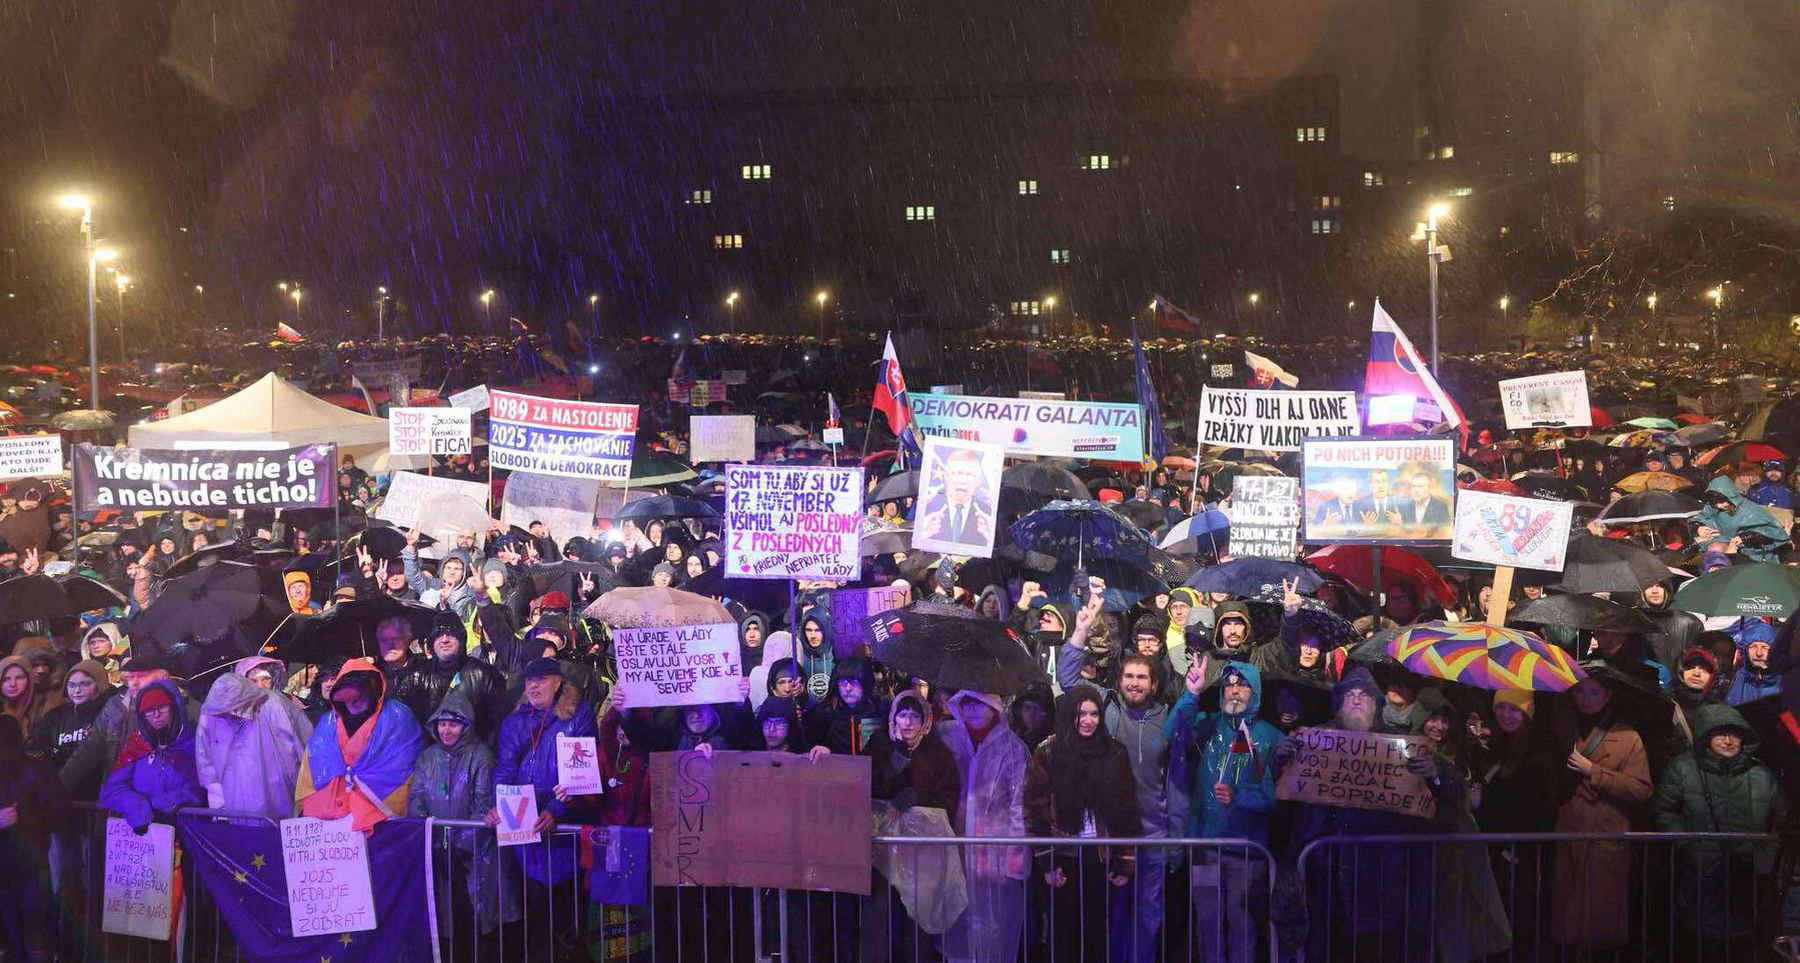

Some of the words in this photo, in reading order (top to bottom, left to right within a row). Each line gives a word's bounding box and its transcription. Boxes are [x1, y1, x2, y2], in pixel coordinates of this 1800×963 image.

[493, 397, 529, 421] 1989
[533, 406, 548, 421] ZA
[552, 408, 633, 429] NASTOLENIE
[912, 400, 1030, 423] DEMOKRATI
[1036, 405, 1138, 428] GALANTA
[1208, 392, 1247, 418] VYŠŠÍ
[1256, 398, 1280, 420] DLH
[1288, 398, 1304, 420] AJ
[1311, 396, 1348, 421] DANE
[394, 411, 426, 425] STOP
[394, 426, 426, 438] STOP
[491, 424, 527, 449] 2025
[530, 432, 546, 448] ZA
[549, 434, 631, 456] ZACHOVANIE
[1204, 419, 1254, 444] ZRÁŽKY
[394, 438, 426, 453] STOP
[435, 438, 470, 453] FICA!
[1314, 447, 1331, 462] PO
[1337, 447, 1370, 462] NICH
[1376, 446, 1446, 461] POTOPA!!!
[94, 454, 228, 481] Kremnica
[236, 457, 281, 481] nie
[287, 454, 315, 483] je
[491, 450, 539, 469] SLOBODY
[541, 461, 547, 471] A
[550, 459, 627, 477] DEMOKRACIE
[97, 487, 114, 505] a
[118, 483, 228, 506] nebude
[233, 478, 317, 505] ticho!
[730, 470, 761, 490] SOM
[811, 473, 824, 491] SI
[830, 473, 850, 493] UŽ
[731, 491, 751, 511] 17.
[757, 491, 836, 512] NOVEMBER
[730, 510, 776, 532] VŠIMOL
[796, 511, 859, 534] POSLEDNÝ
[733, 532, 744, 550] Z
[752, 532, 842, 554] POSLEDNÝCH
[620, 633, 634, 644] NA
[638, 629, 670, 644] ÚRADE
[676, 626, 713, 641] VLÁDY
[871, 618, 890, 643] PARIS
[651, 643, 687, 656] STÁLE
[625, 671, 641, 683] MY
[644, 670, 664, 682] ALE
[667, 667, 698, 680] VIEME
[701, 666, 722, 678] KDE
[724, 664, 740, 677] JE
[1300, 769, 1321, 780] SA
[1339, 757, 1404, 778] KONIEC
[1297, 780, 1306, 792] V
[1317, 784, 1414, 809] POPRADE
[288, 850, 315, 863] VITAJ
[319, 846, 360, 861] SLOBODA
[300, 868, 337, 884] 2025
[292, 884, 349, 903] NEDAJME
